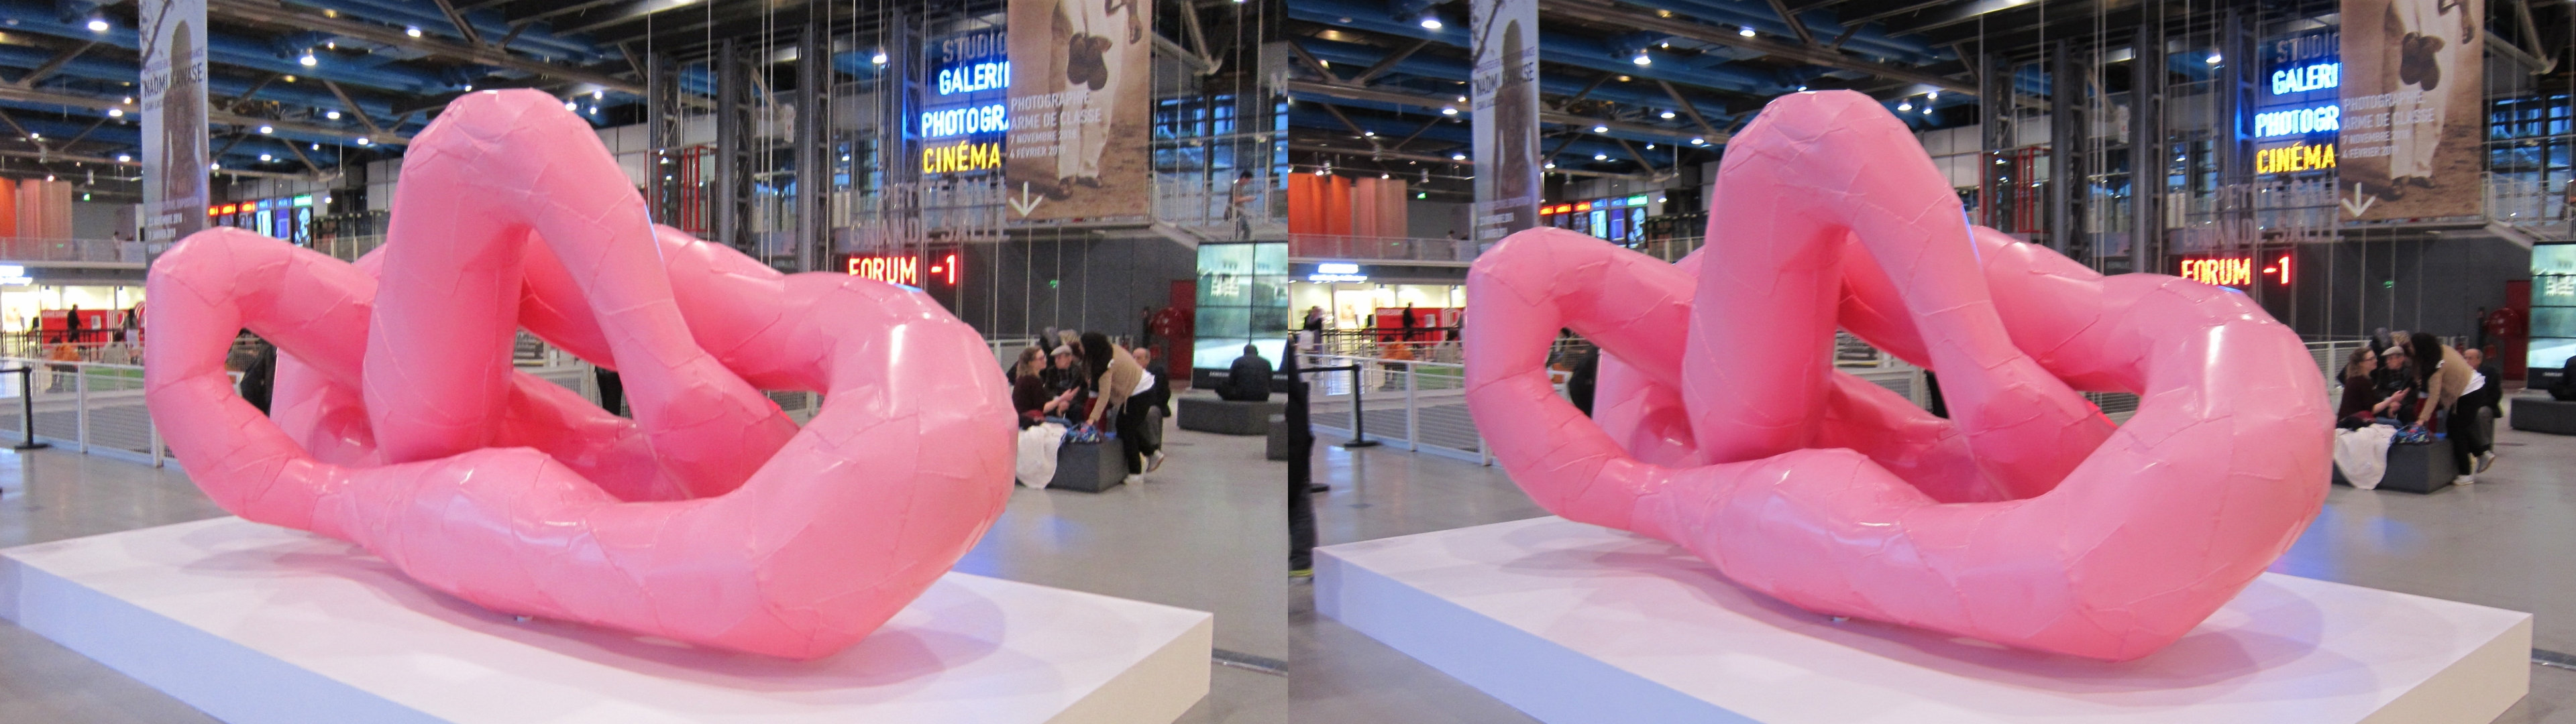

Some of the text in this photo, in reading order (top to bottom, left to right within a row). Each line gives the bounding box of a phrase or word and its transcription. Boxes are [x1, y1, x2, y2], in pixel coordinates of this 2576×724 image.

[943, 32, 1008, 63] STUDIO
[144, 62, 203, 98] NAOMI KAWASE
[2272, 62, 2342, 95] GALERI
[1010, 107, 1102, 130] ARME DE CLASSE
[2344, 107, 2435, 130] ARME DE CLASSE
[1009, 148, 1014, 160] 4
[1016, 145, 1047, 159] FÉVRIER
[1010, 133, 1014, 145] 7
[1016, 130, 1057, 145] NOVEMBRE
[2350, 131, 2390, 145] NOVEMBRE
[923, 140, 1001, 174] CINÉMA
[2256, 141, 2337, 174] CINÉMA
[850, 209, 1010, 247] GRANDE SALLE
[849, 255, 955, 285] FORUM -1
[2181, 256, 2290, 286] FORUM -1
